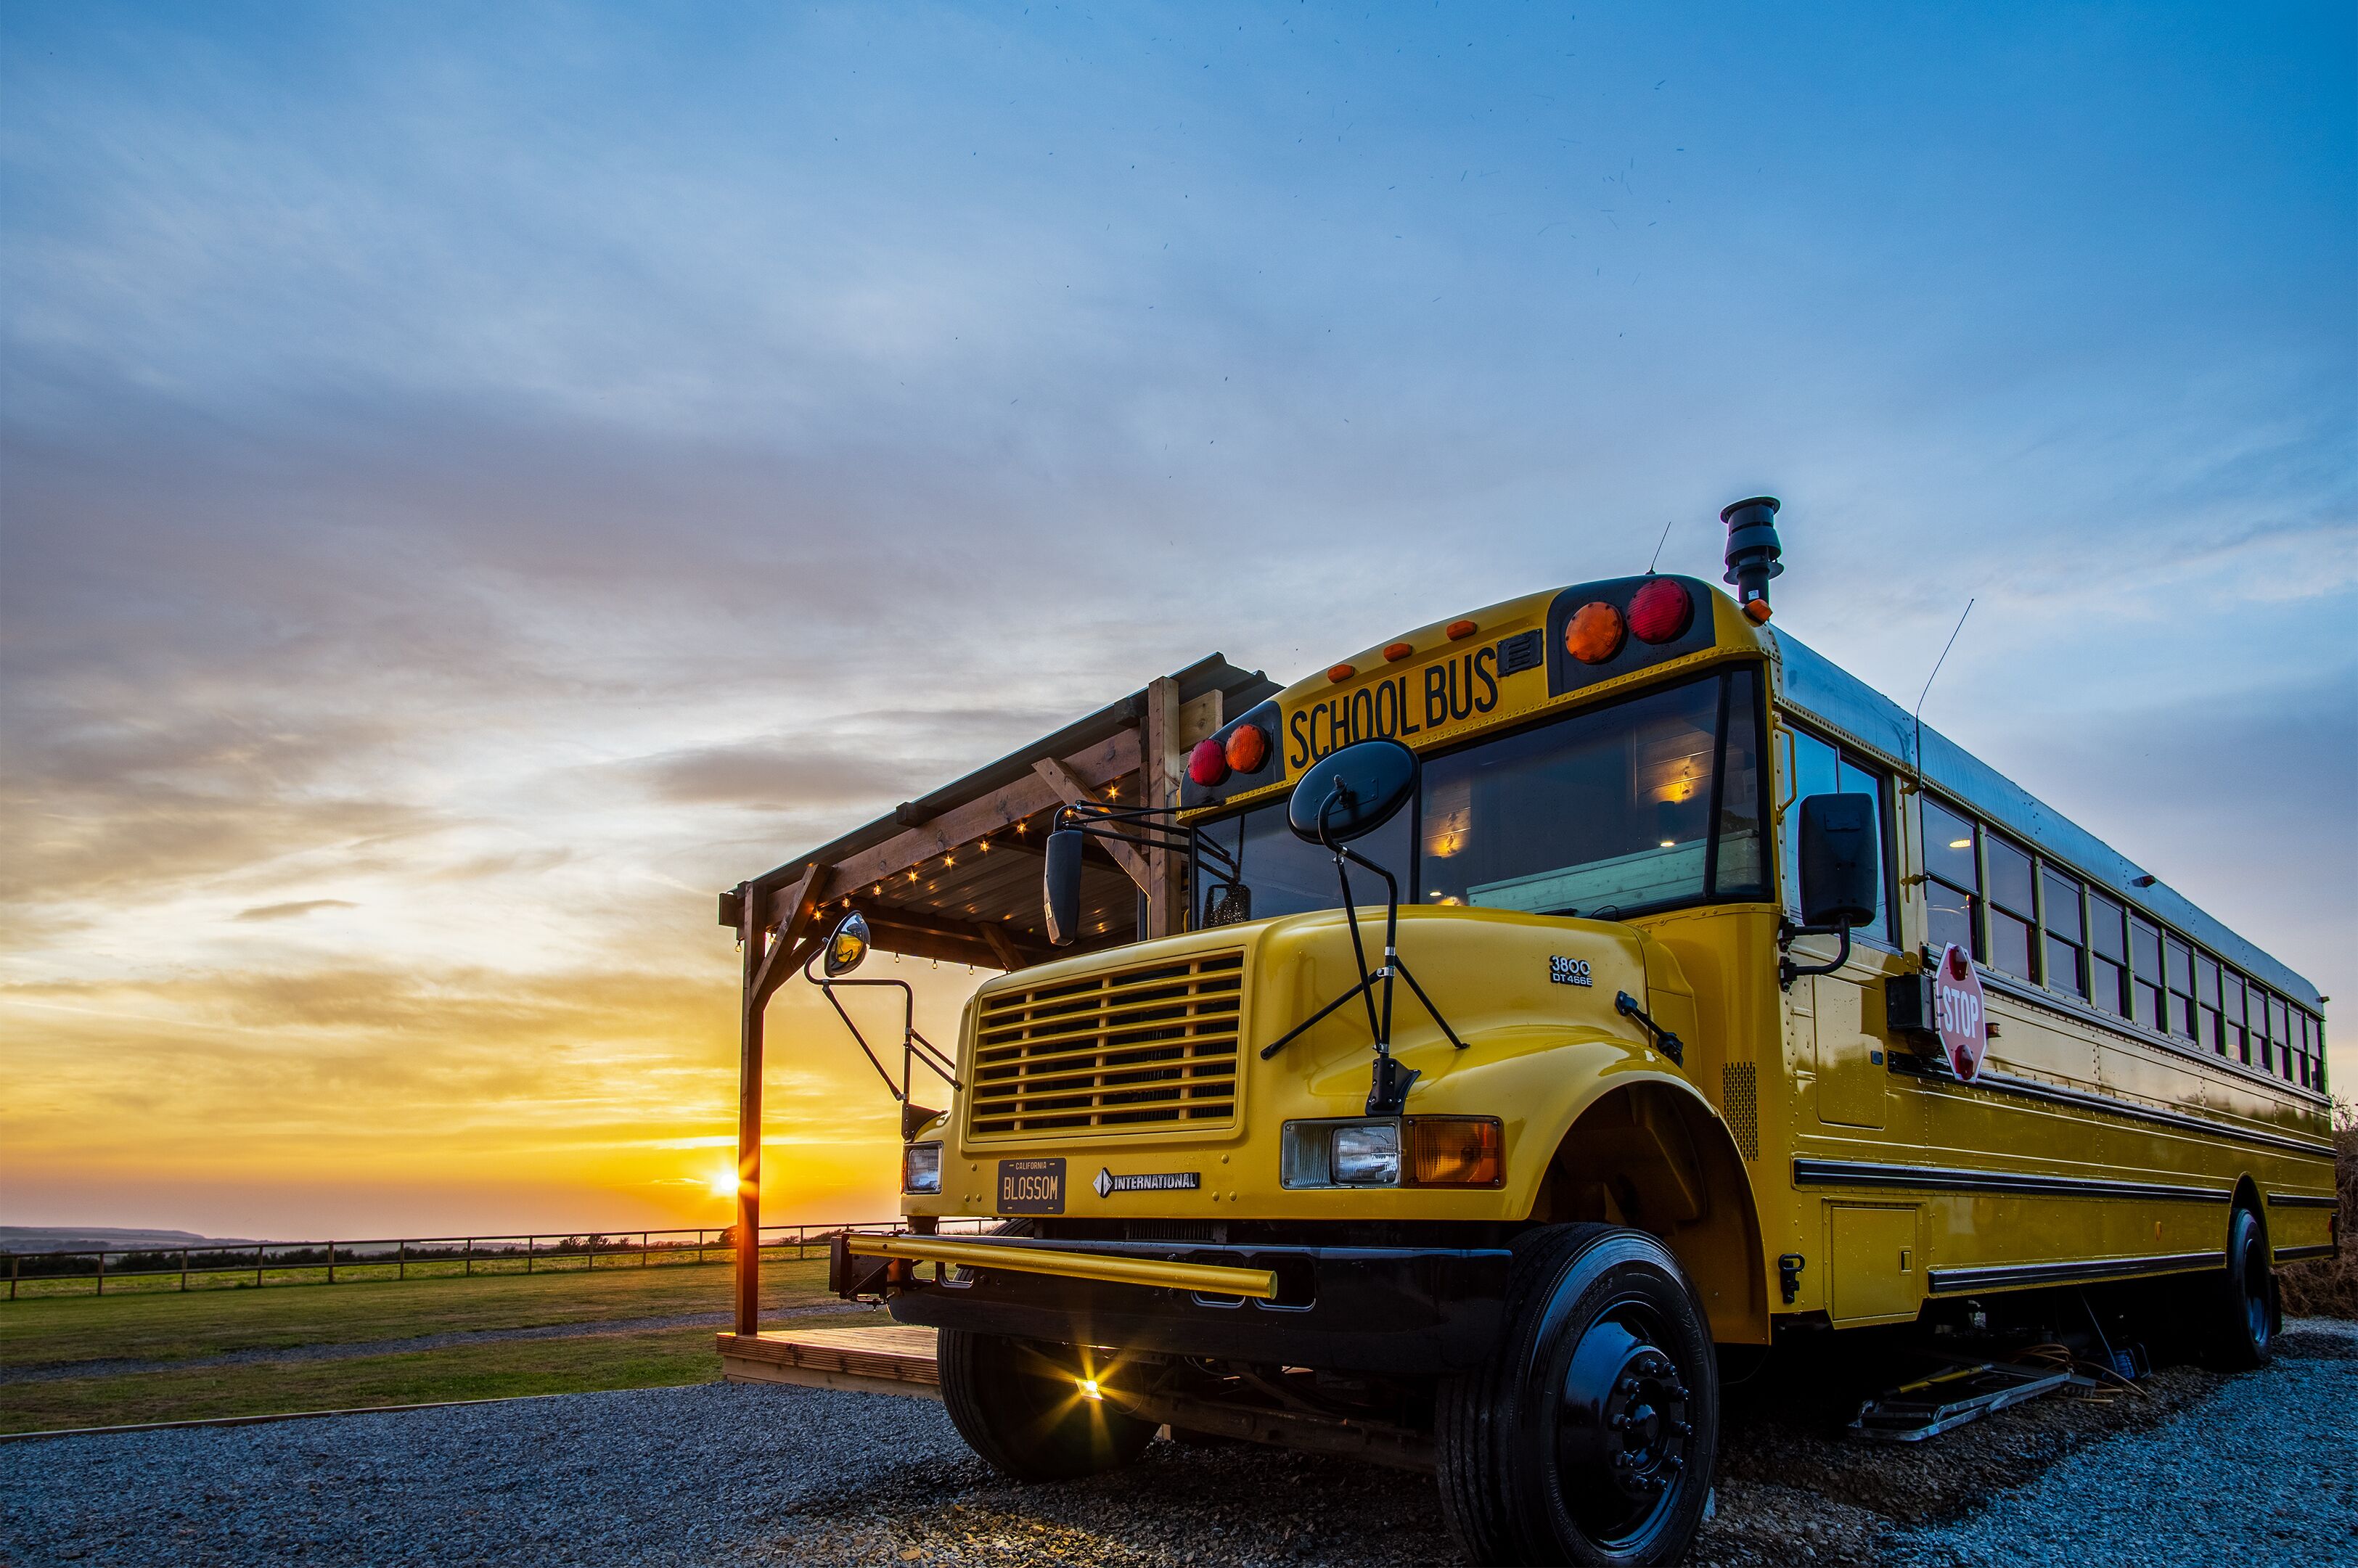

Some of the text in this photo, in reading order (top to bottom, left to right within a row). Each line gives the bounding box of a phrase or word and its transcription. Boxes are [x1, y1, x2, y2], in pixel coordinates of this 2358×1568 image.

[1290, 647, 1499, 769] SCHOOL BUS
[1551, 955, 1591, 976] 3800
[1942, 985, 1979, 1038] STOP
[1015, 1161, 1047, 1170] CALIFORNIA
[1003, 1175, 1058, 1201] BLOSSOM
[1113, 1173, 1196, 1190] INTERNATIONAL
